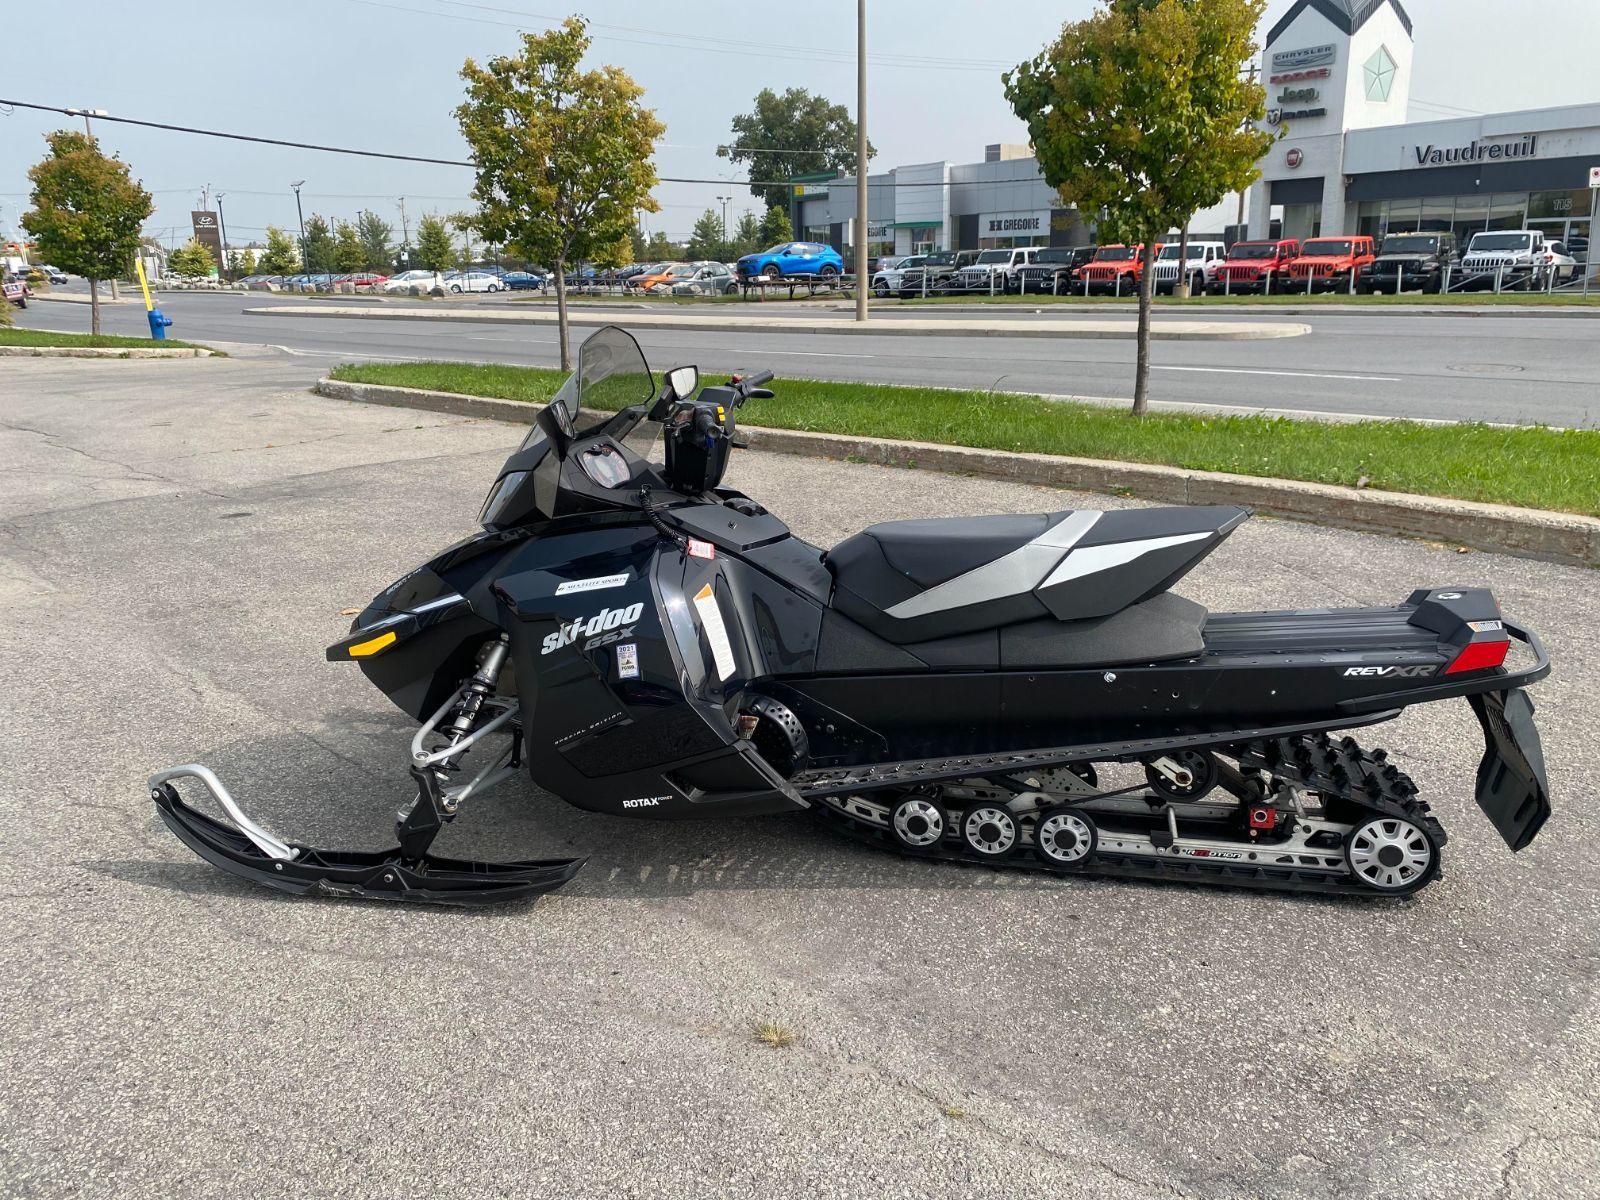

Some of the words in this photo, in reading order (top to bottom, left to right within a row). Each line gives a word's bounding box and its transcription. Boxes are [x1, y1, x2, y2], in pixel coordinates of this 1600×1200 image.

[1274, 46, 1332, 60] CHRYSLER
[1415, 136, 1537, 165] Vaudreuil
[867, 226, 887, 237] EGOIRE
[584, 625, 637, 651] GSX
[618, 645, 634, 653] 2021
[622, 797, 660, 808] ROTAX
